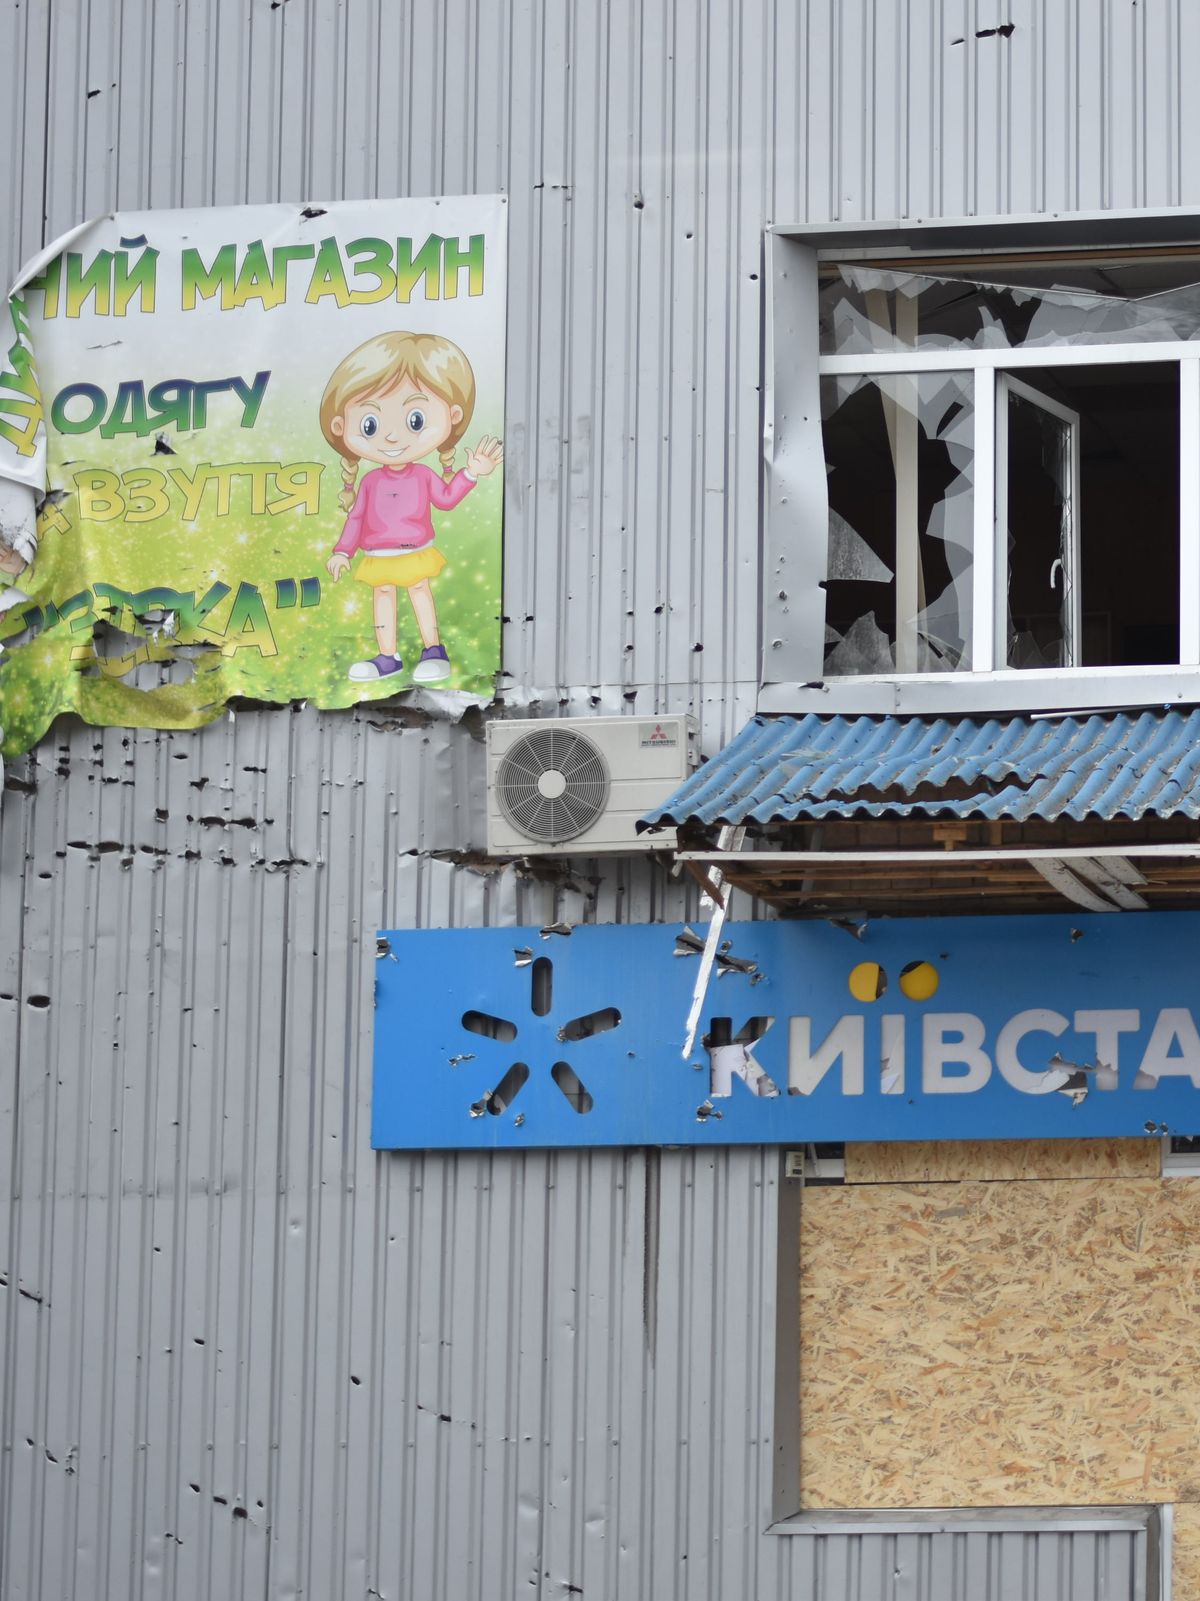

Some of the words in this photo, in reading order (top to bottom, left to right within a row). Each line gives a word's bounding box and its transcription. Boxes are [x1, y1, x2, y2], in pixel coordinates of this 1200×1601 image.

[181, 233, 485, 312] МАГАЗИН
[51, 370, 272, 440] ОДЯГУ
[73, 461, 326, 522] ВЗУТТЯ
